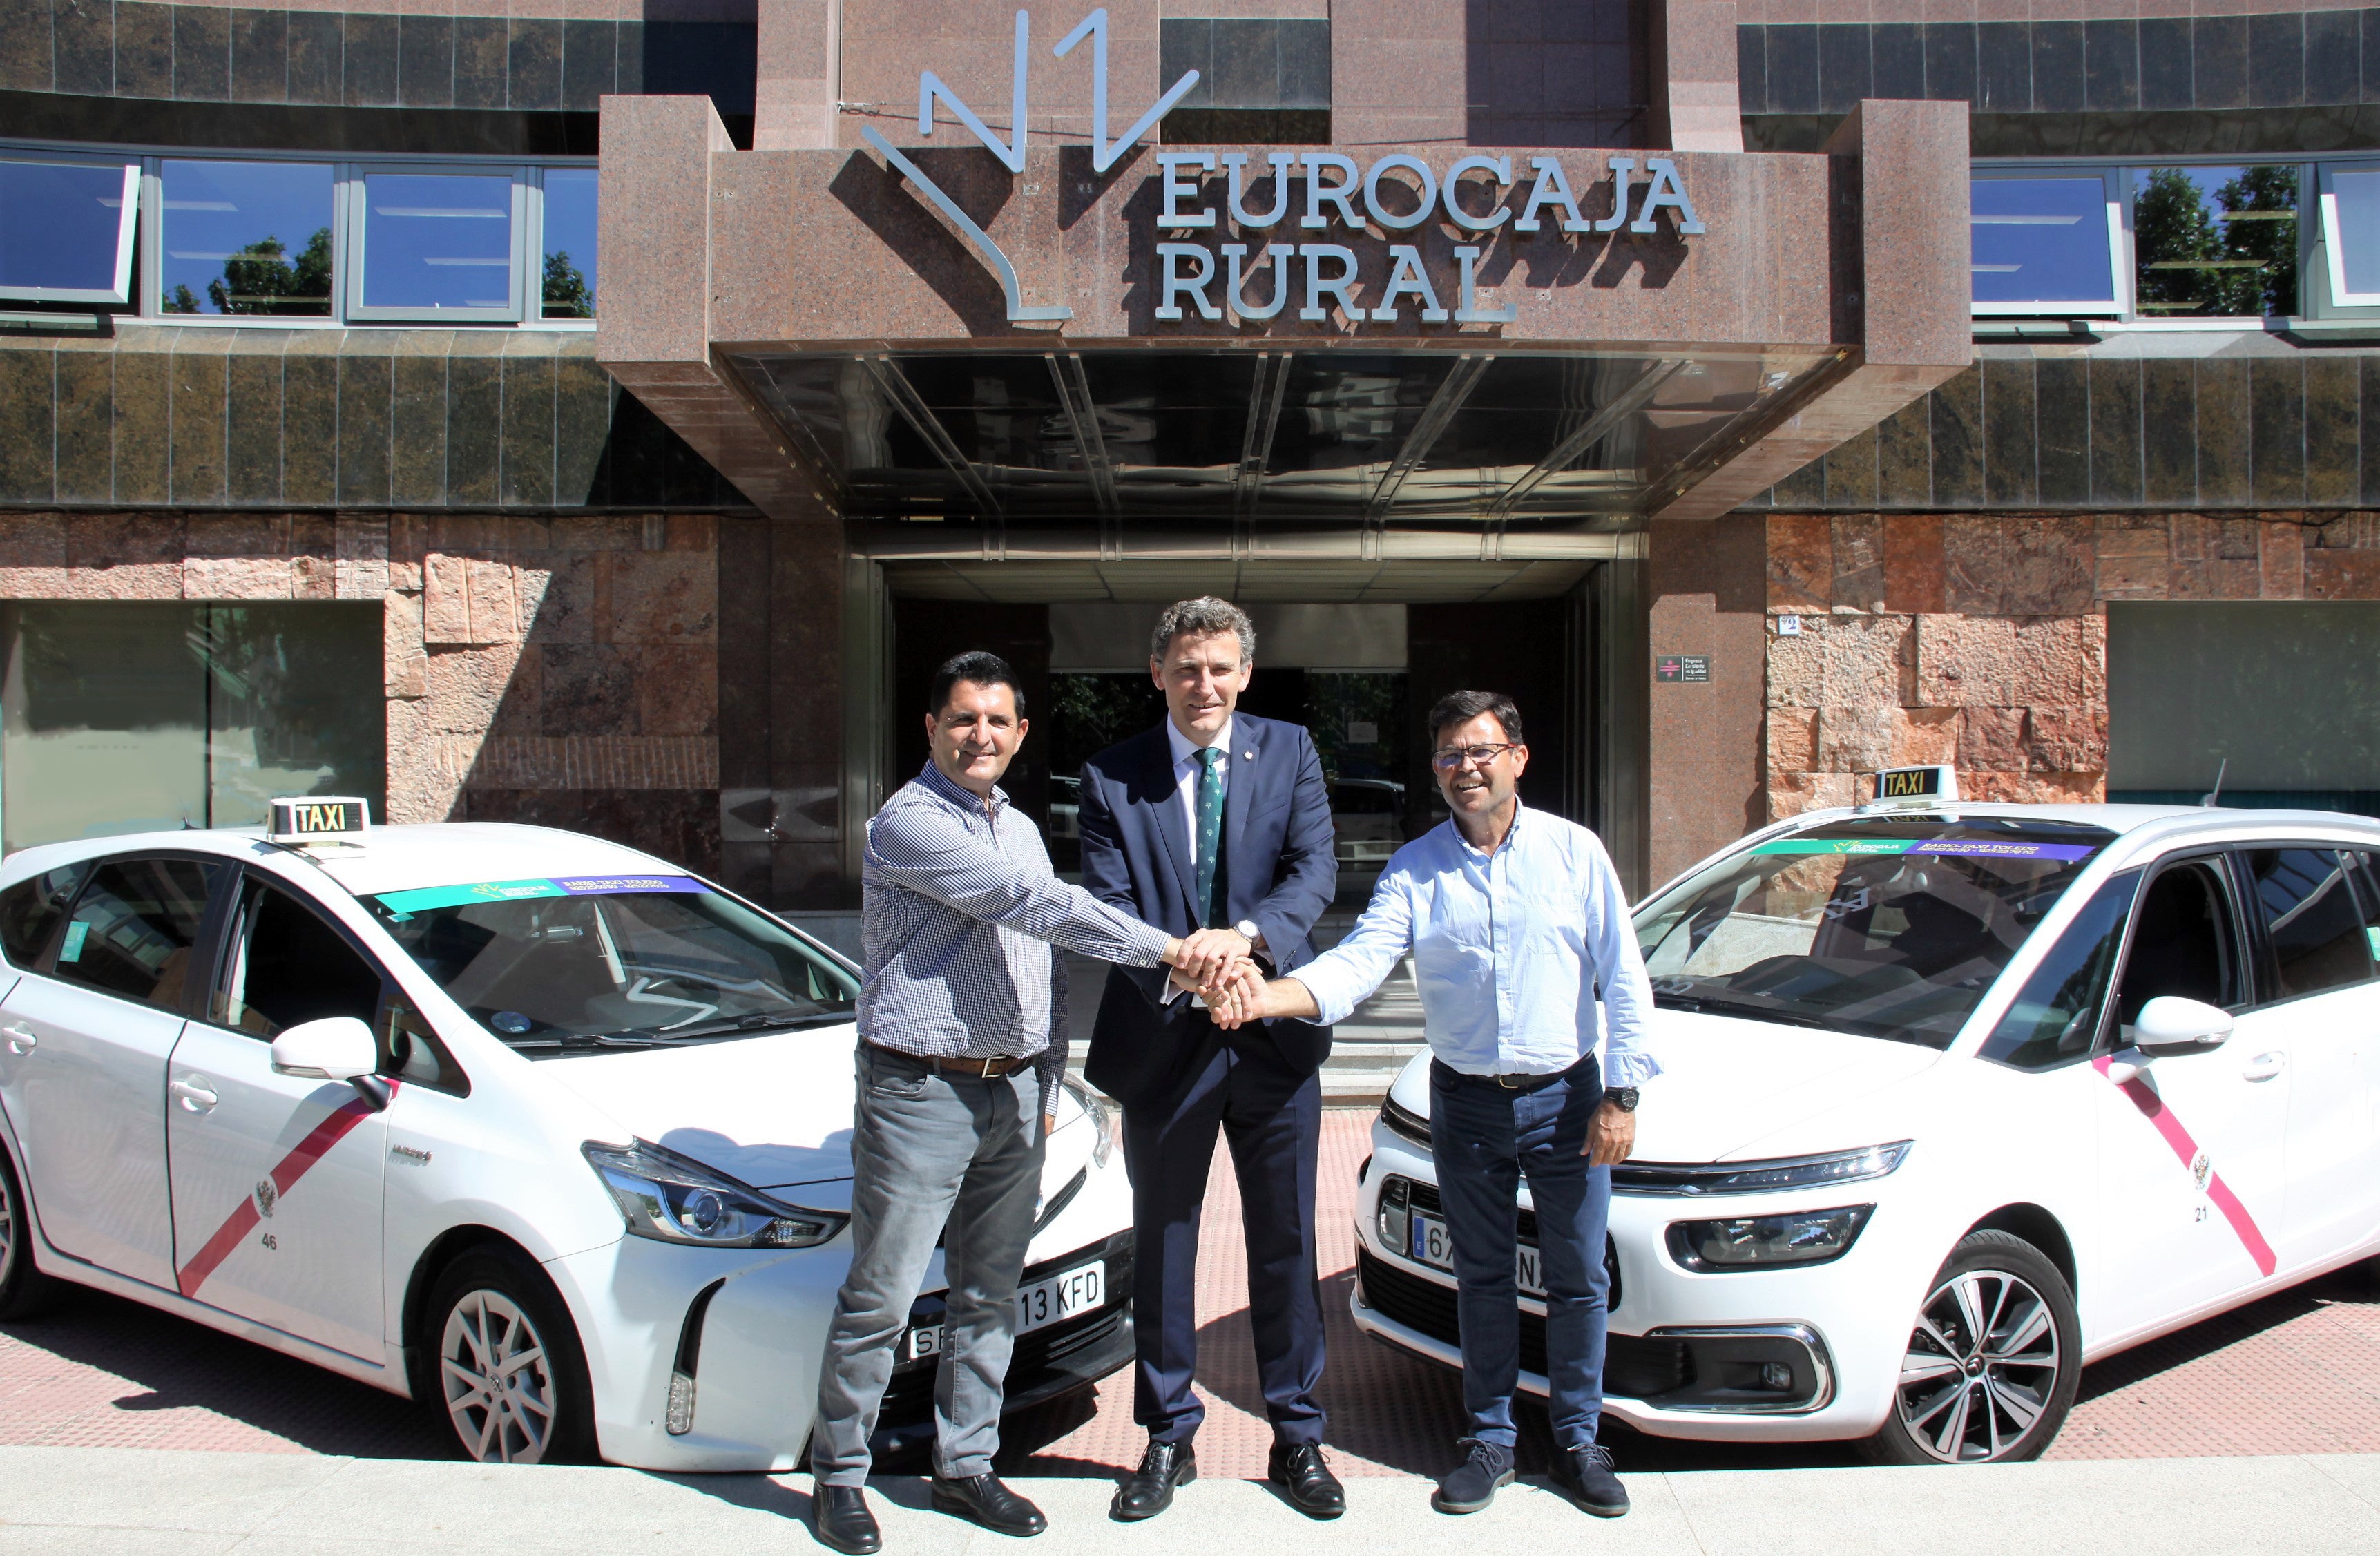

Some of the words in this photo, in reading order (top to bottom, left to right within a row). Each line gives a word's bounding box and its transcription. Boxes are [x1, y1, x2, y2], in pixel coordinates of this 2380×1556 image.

[1156, 152, 1706, 235] EUROCAJA
[1155, 242, 1517, 323] RURAL
[1886, 771, 1924, 796] TAXI
[296, 805, 345, 832] TAXI
[2195, 1205, 2207, 1222] 21
[262, 1233, 277, 1250] 46
[1021, 1289, 1048, 1326] 13
[1057, 1271, 1097, 1314] KFD
